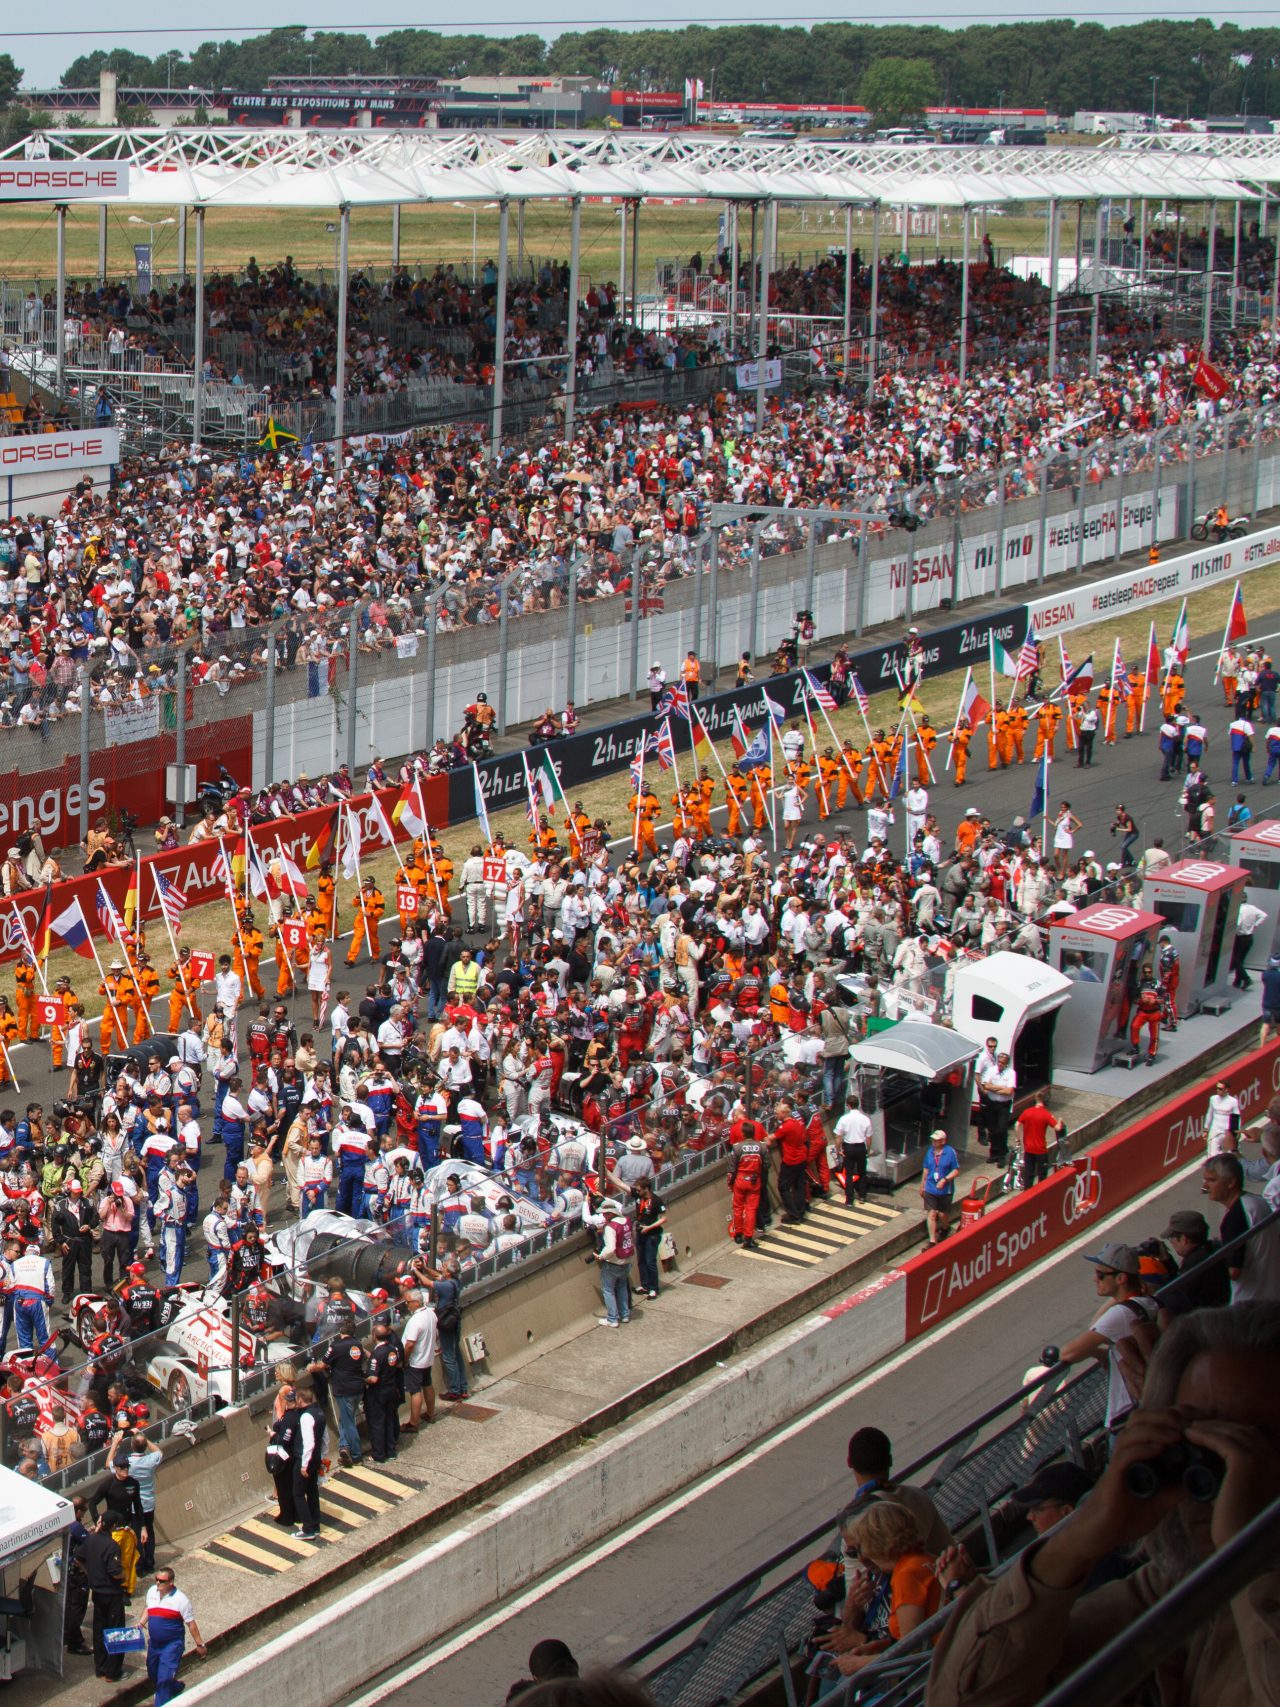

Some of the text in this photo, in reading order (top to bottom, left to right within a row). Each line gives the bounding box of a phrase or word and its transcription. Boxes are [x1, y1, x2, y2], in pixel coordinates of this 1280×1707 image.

[233, 96, 395, 109] CENTRE DES EXPOSITIONS DU MANS
[974, 534, 1033, 571] nimo
[889, 553, 954, 590] NISSAN
[1092, 569, 1181, 612] #eatsleepRACErepeat
[1032, 601, 1076, 632] NISSAN
[921, 647, 941, 665] ANS
[592, 733, 616, 767] 24h
[617, 738, 634, 759] LE
[477, 765, 503, 800] 24h
[504, 771, 522, 793] LE
[485, 857, 505, 865] MOTUL
[486, 866, 503, 881] 17
[398, 886, 418, 895] MOTUL
[399, 894, 416, 911] 19
[284, 918, 306, 928] MOTUL
[289, 928, 300, 945] 8
[192, 950, 214, 960] MOTUL
[196, 961, 209, 977] 7
[38, 995, 62, 1005] MOTUL
[44, 1006, 57, 1024] 9
[518, 1206, 540, 1222] DENSO
[947, 1211, 1048, 1298] Audi Sport
[187, 1333, 212, 1352] ARCTIC
